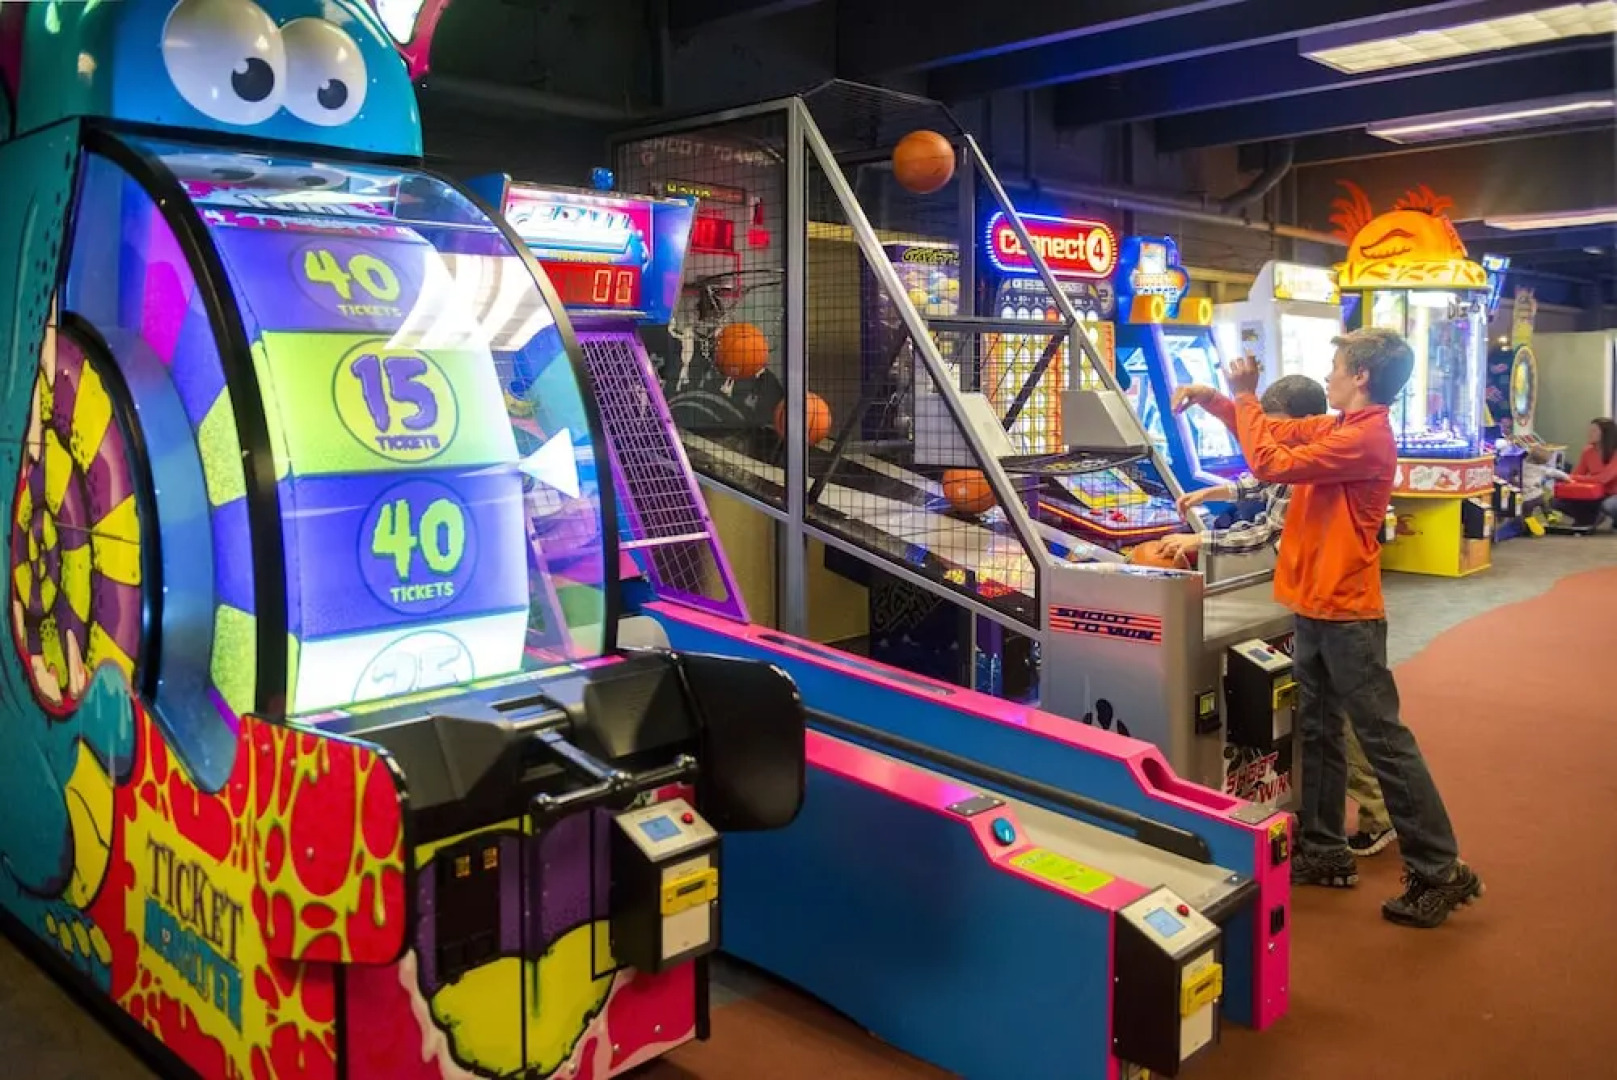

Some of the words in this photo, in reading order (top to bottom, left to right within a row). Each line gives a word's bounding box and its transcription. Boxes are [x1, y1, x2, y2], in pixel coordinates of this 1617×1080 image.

[304, 249, 400, 302] 40
[593, 269, 633, 304] 00
[336, 303, 402, 318] TICKETS
[350, 353, 438, 433] 15
[374, 434, 440, 451] TICKETS
[372, 498, 465, 581] 40
[389, 581, 454, 604] TICKETS
[1056, 607, 1137, 624] SHOOT
[1072, 621, 1099, 633] TO
[1105, 625, 1154, 641] WIN
[147, 831, 243, 965] TICKET
